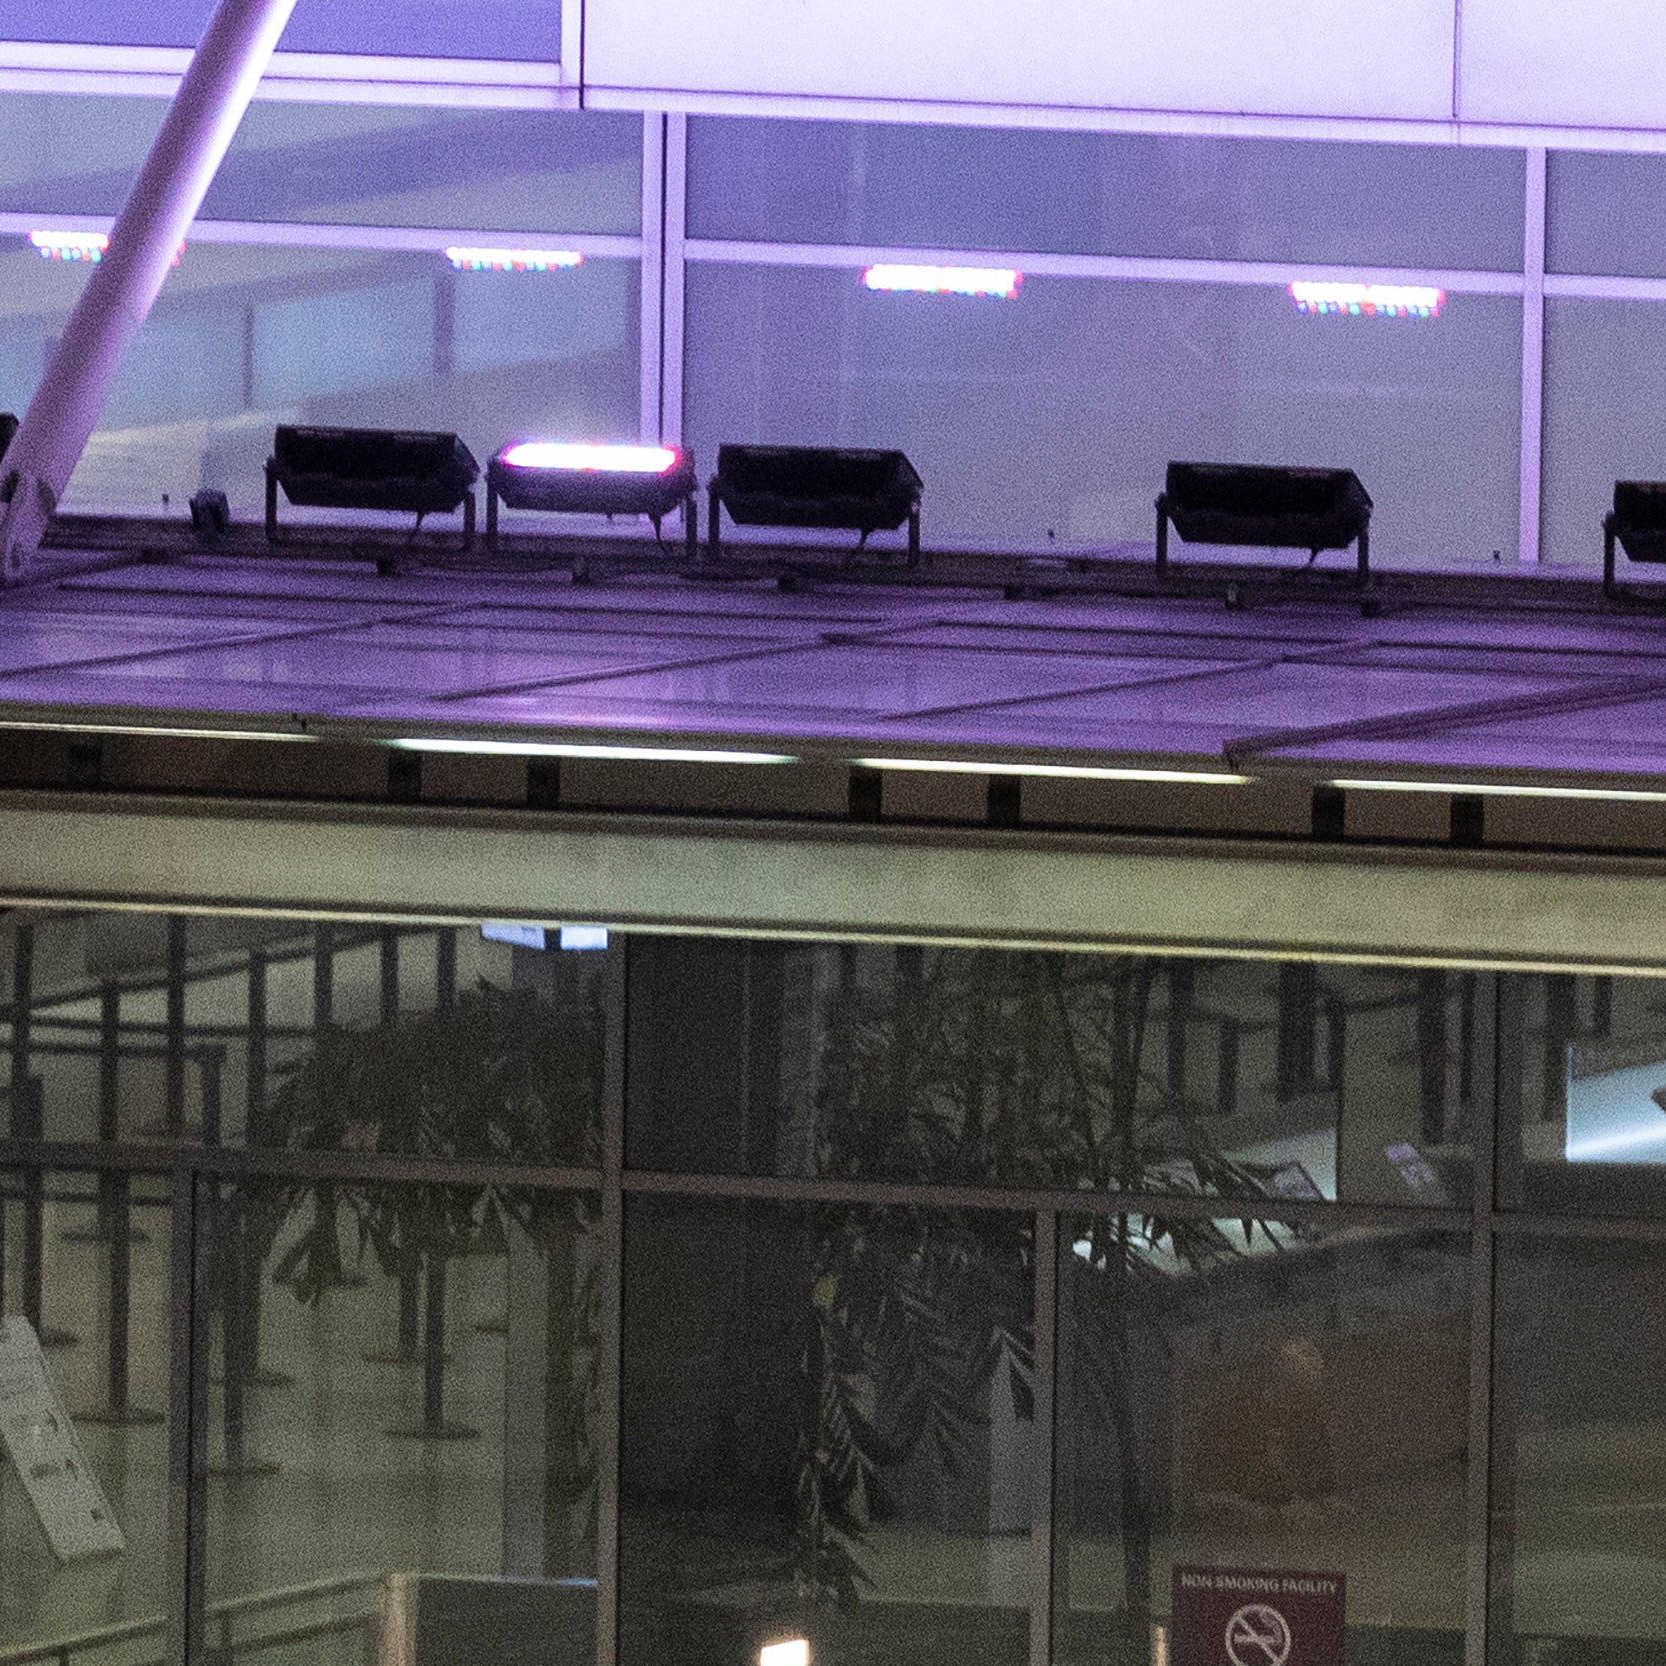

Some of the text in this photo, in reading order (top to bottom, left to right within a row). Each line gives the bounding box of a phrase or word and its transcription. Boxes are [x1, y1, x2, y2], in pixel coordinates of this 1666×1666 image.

[1183, 1573, 1337, 1593] NON SMOKING FACILITY
